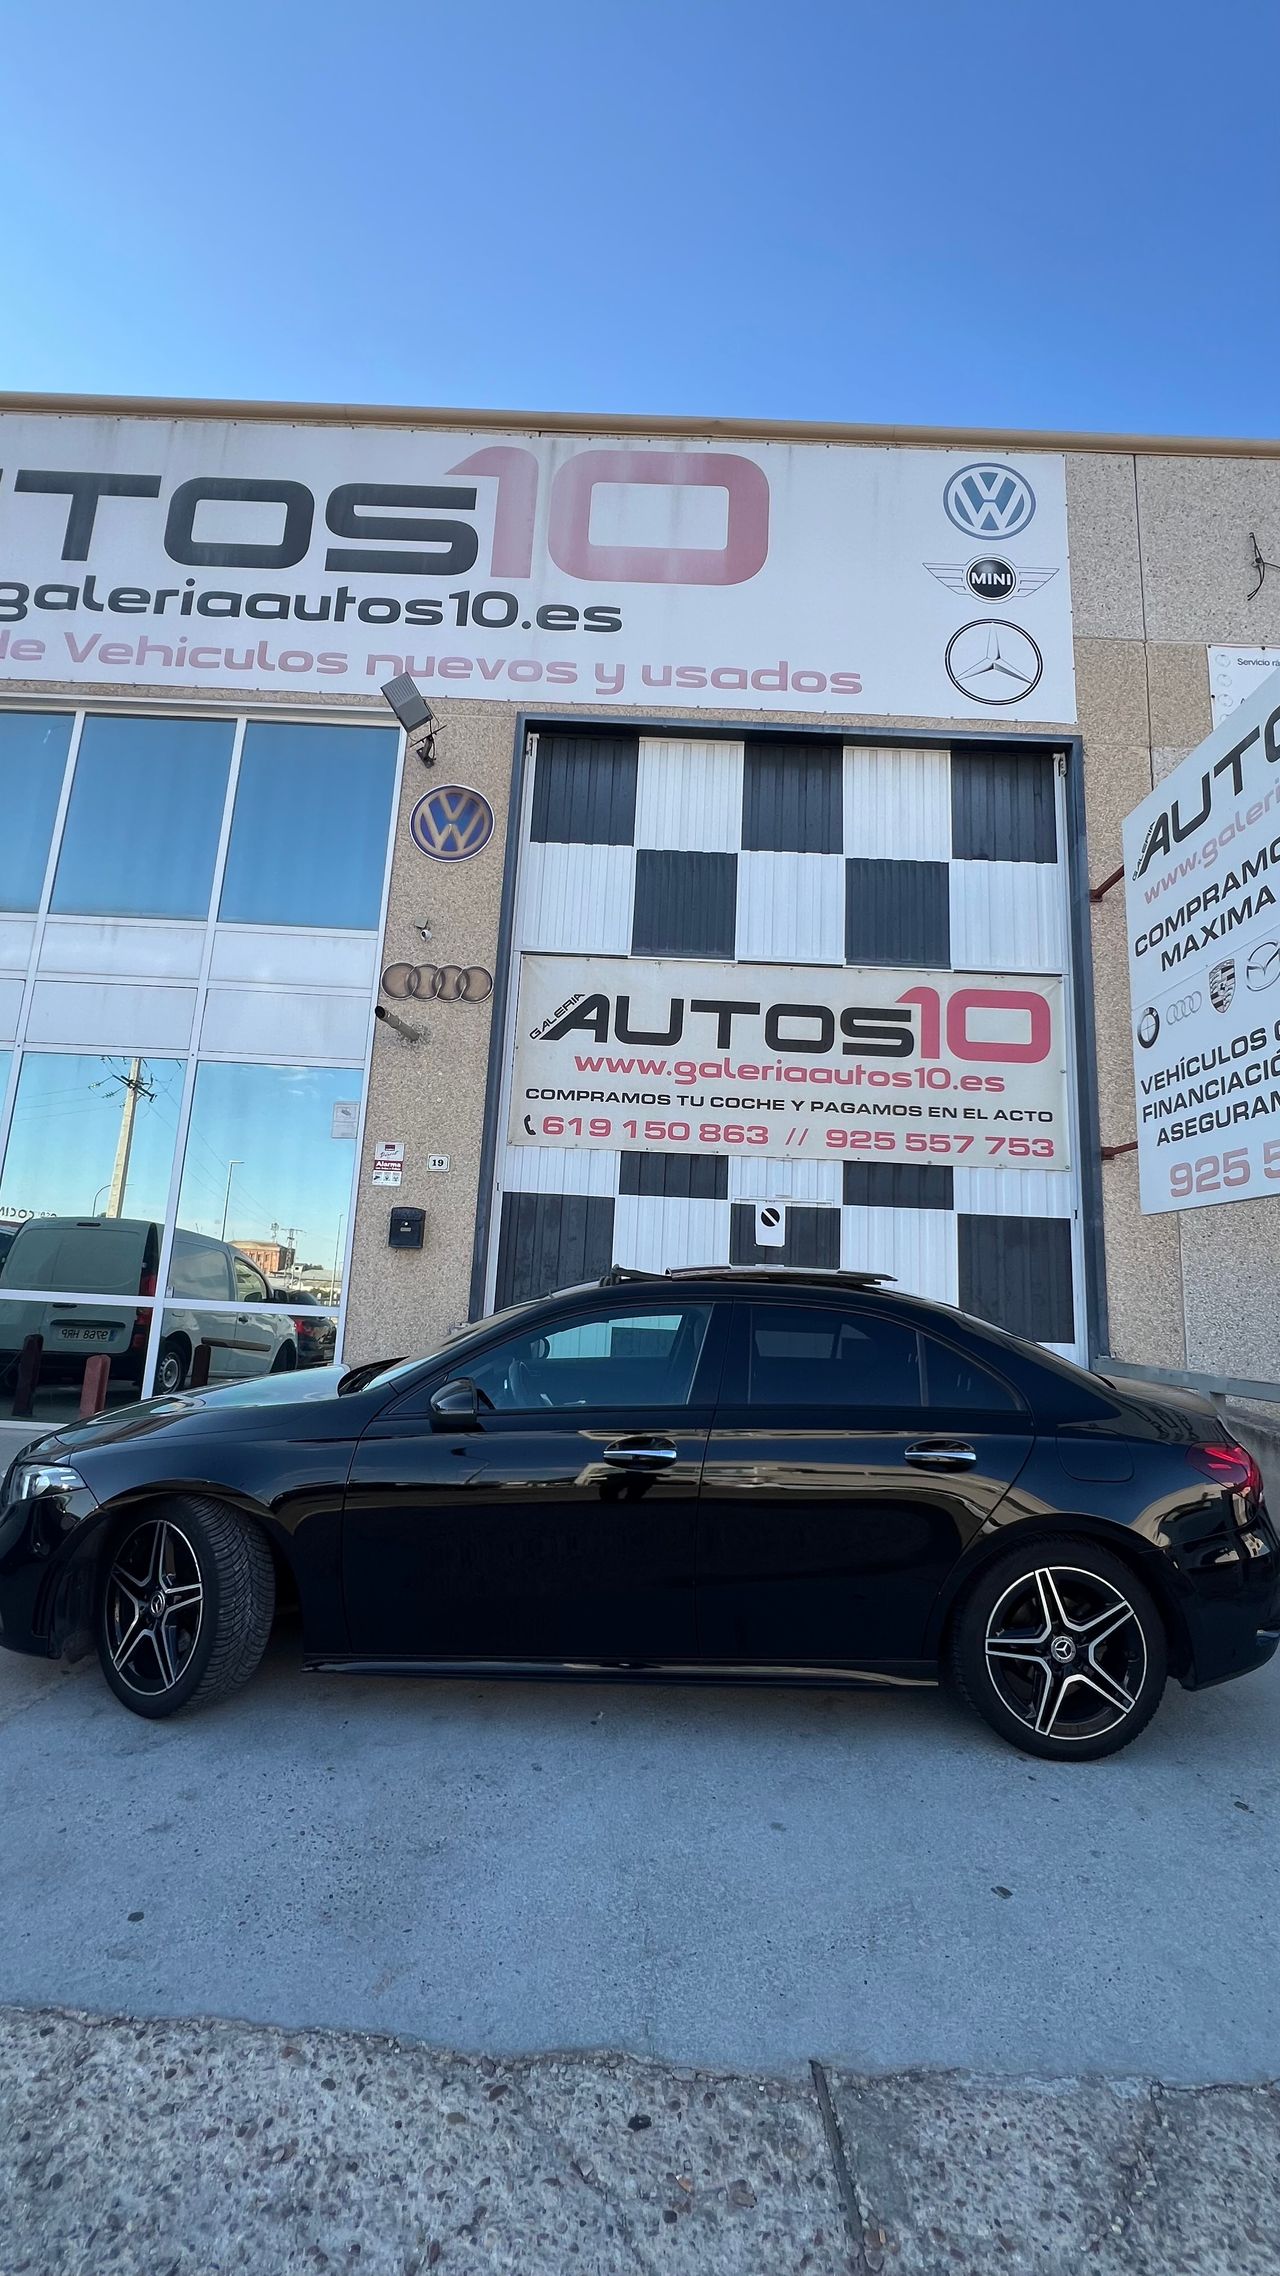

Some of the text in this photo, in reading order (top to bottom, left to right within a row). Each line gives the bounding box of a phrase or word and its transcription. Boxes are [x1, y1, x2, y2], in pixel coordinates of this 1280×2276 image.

[0, 445, 769, 585] TOS10
[971, 572, 1012, 586] MINI
[64, 631, 348, 674] Vehiculos
[366, 653, 579, 685] nuevos
[594, 662, 625, 695] y
[641, 660, 863, 695] usados
[1237, 658, 1270, 666] Servicio
[1161, 885, 1277, 972] MAXIMA
[529, 993, 585, 1040] GALERIA
[574, 1056, 1005, 1092] www.galeriaautos10.es
[1140, 1027, 1267, 1095] VEHÍCULOS
[525, 1088, 1053, 1122] COMPRAMOS TU COCHE Y PAGAMOS EN EL ACTO
[542, 1116, 611, 1137] 619
[623, 1120, 690, 1140] 150
[699, 1124, 769, 1144] 863
[825, 1129, 896, 1150] 925
[905, 1133, 974, 1154] 557
[985, 1137, 1054, 1158] 753
[1170, 1148, 1250, 1197] 925
